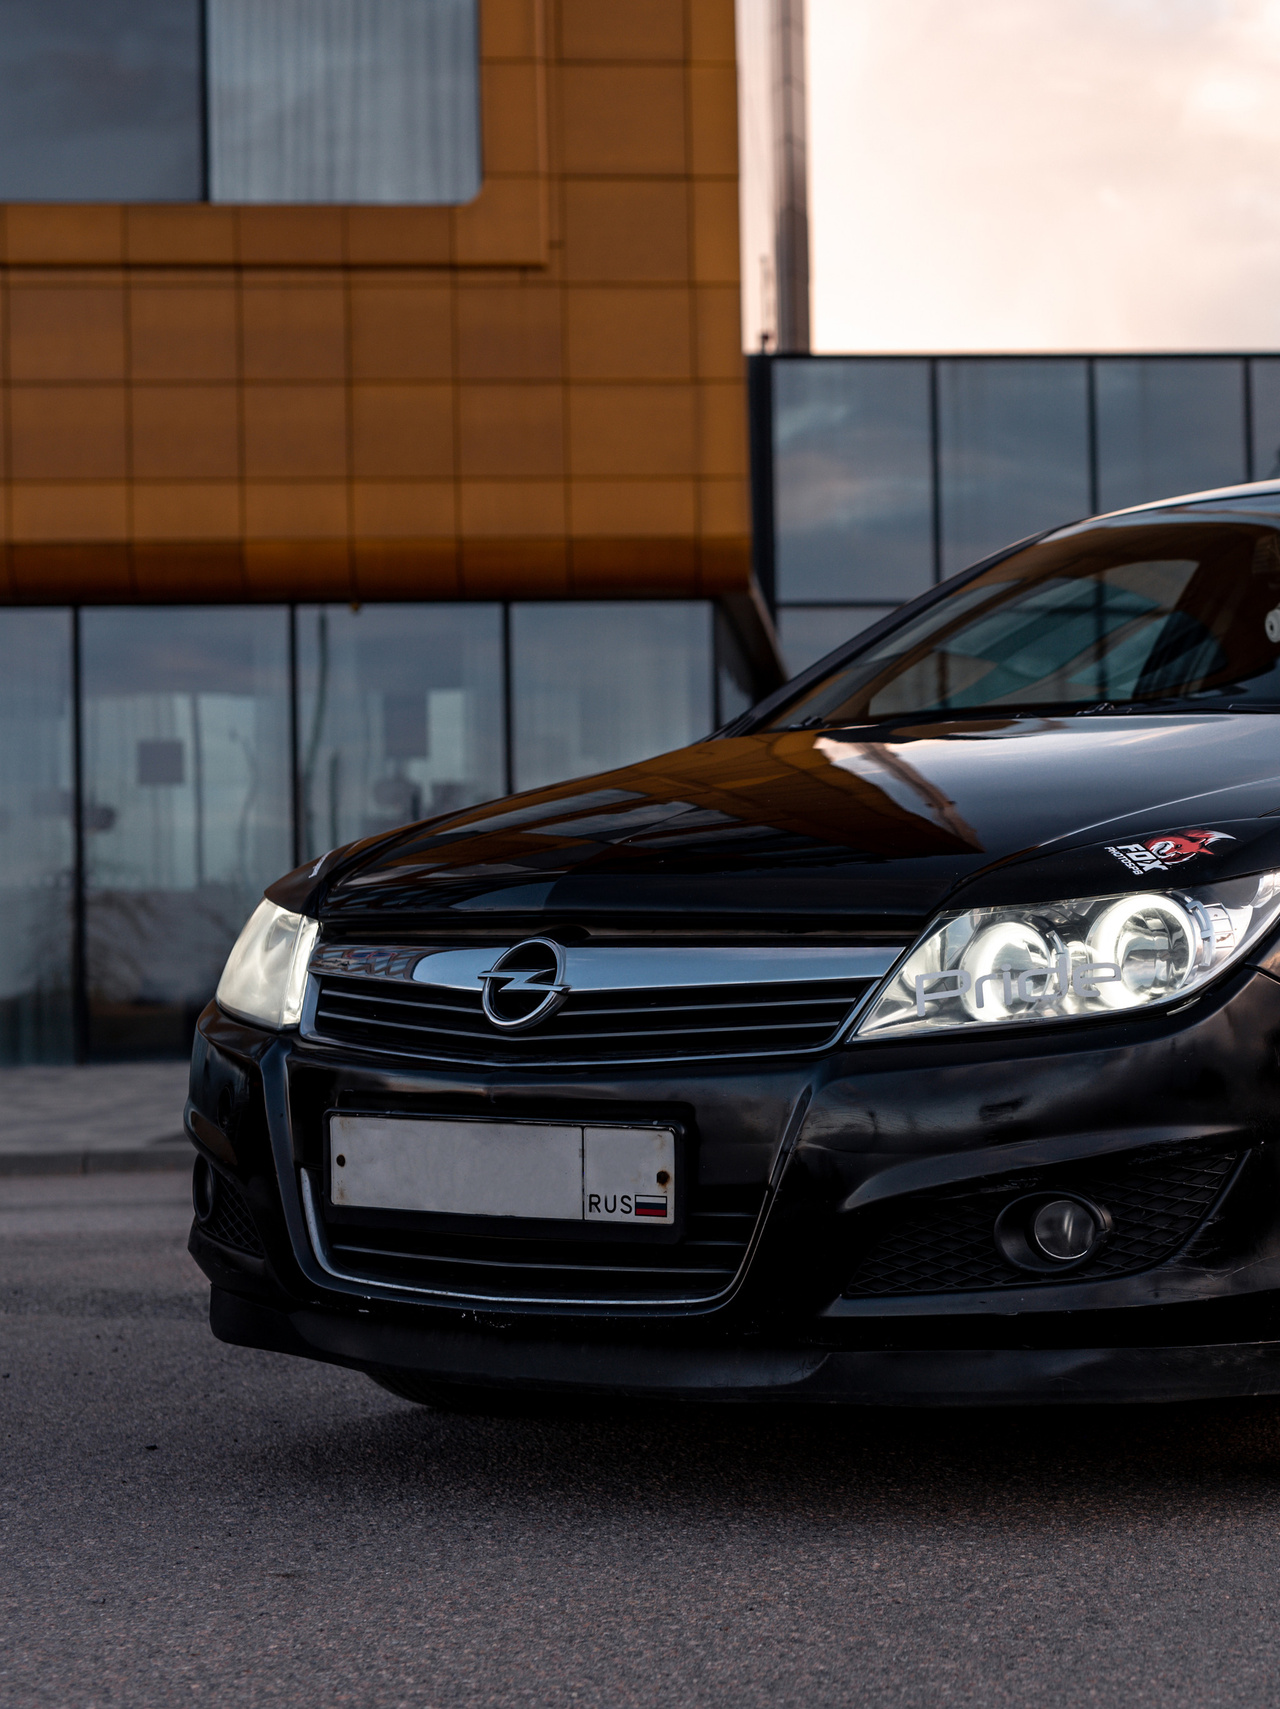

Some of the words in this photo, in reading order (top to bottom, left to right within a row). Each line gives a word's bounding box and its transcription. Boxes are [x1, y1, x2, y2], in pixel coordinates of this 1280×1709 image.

[1104, 846, 1144, 876] PHOTOSPB
[1116, 843, 1168, 872] FOX
[915, 955, 1121, 1017] Pride
[589, 1194, 632, 1214] RUS
